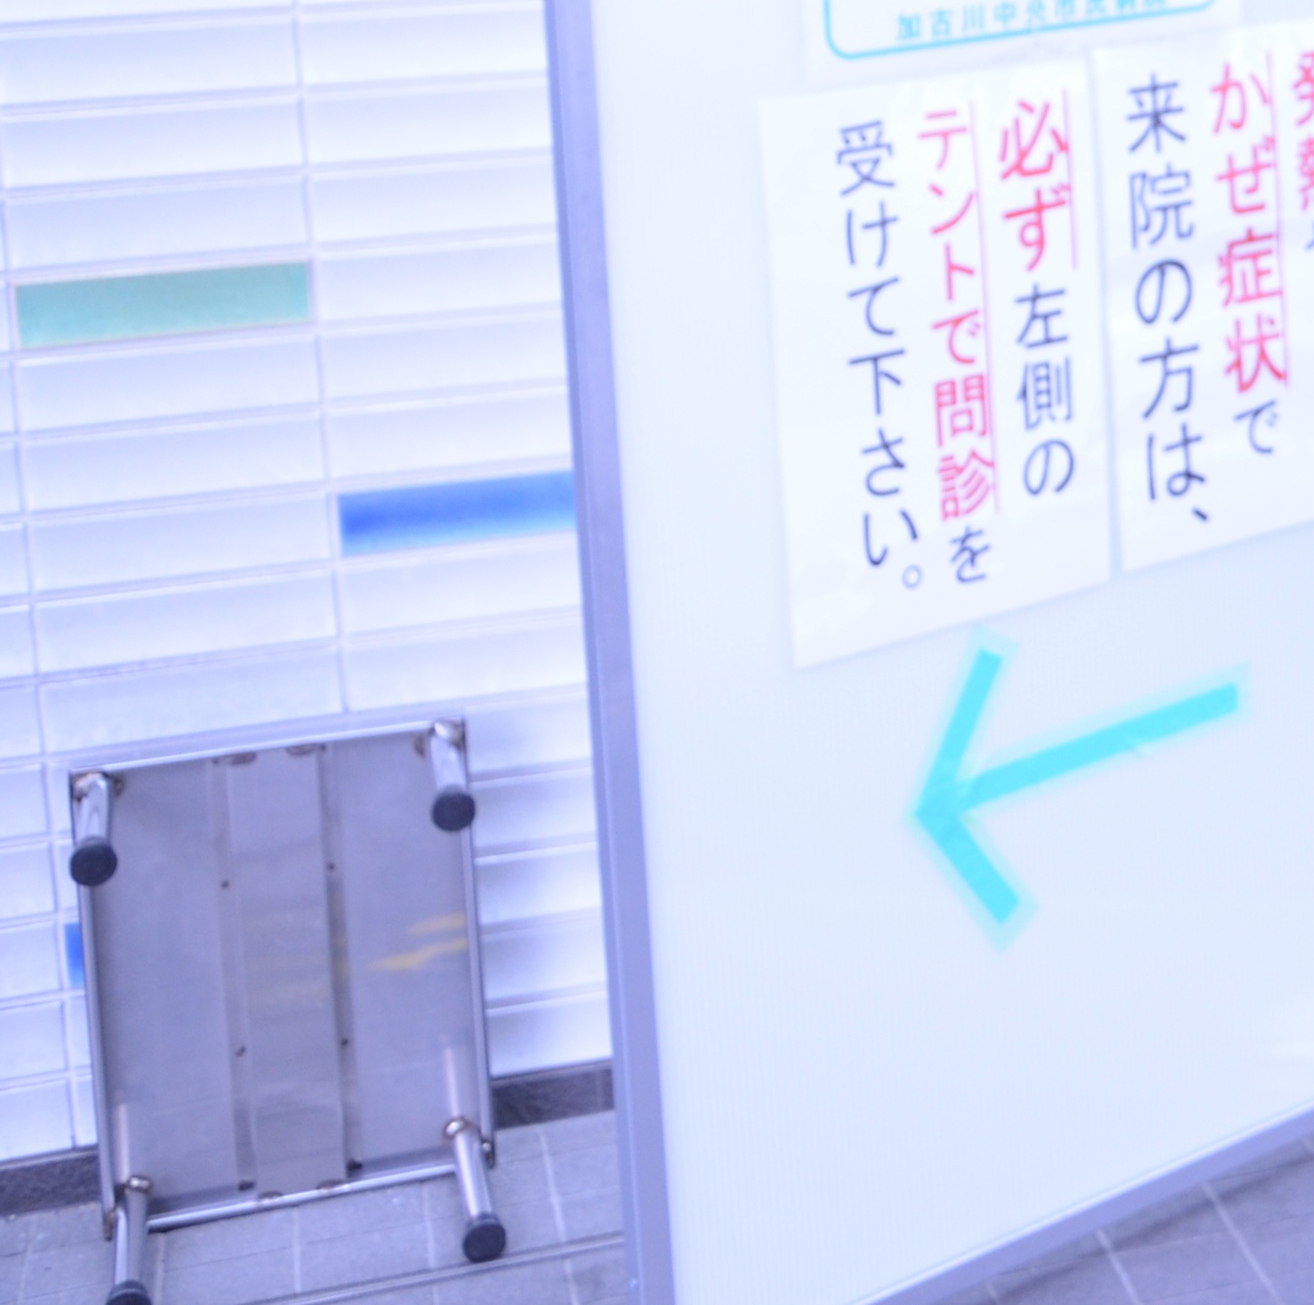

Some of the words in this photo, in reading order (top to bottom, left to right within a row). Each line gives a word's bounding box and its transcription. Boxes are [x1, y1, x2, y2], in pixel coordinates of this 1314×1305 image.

[835, 118, 923, 590] 受けて下さい。
[916, 108, 997, 585] テントで問診を
[998, 98, 1075, 498] 必ず左側の
[1125, 72, 1209, 523] 来院の方は、
[1209, 62, 1288, 456] かぜ症状で
